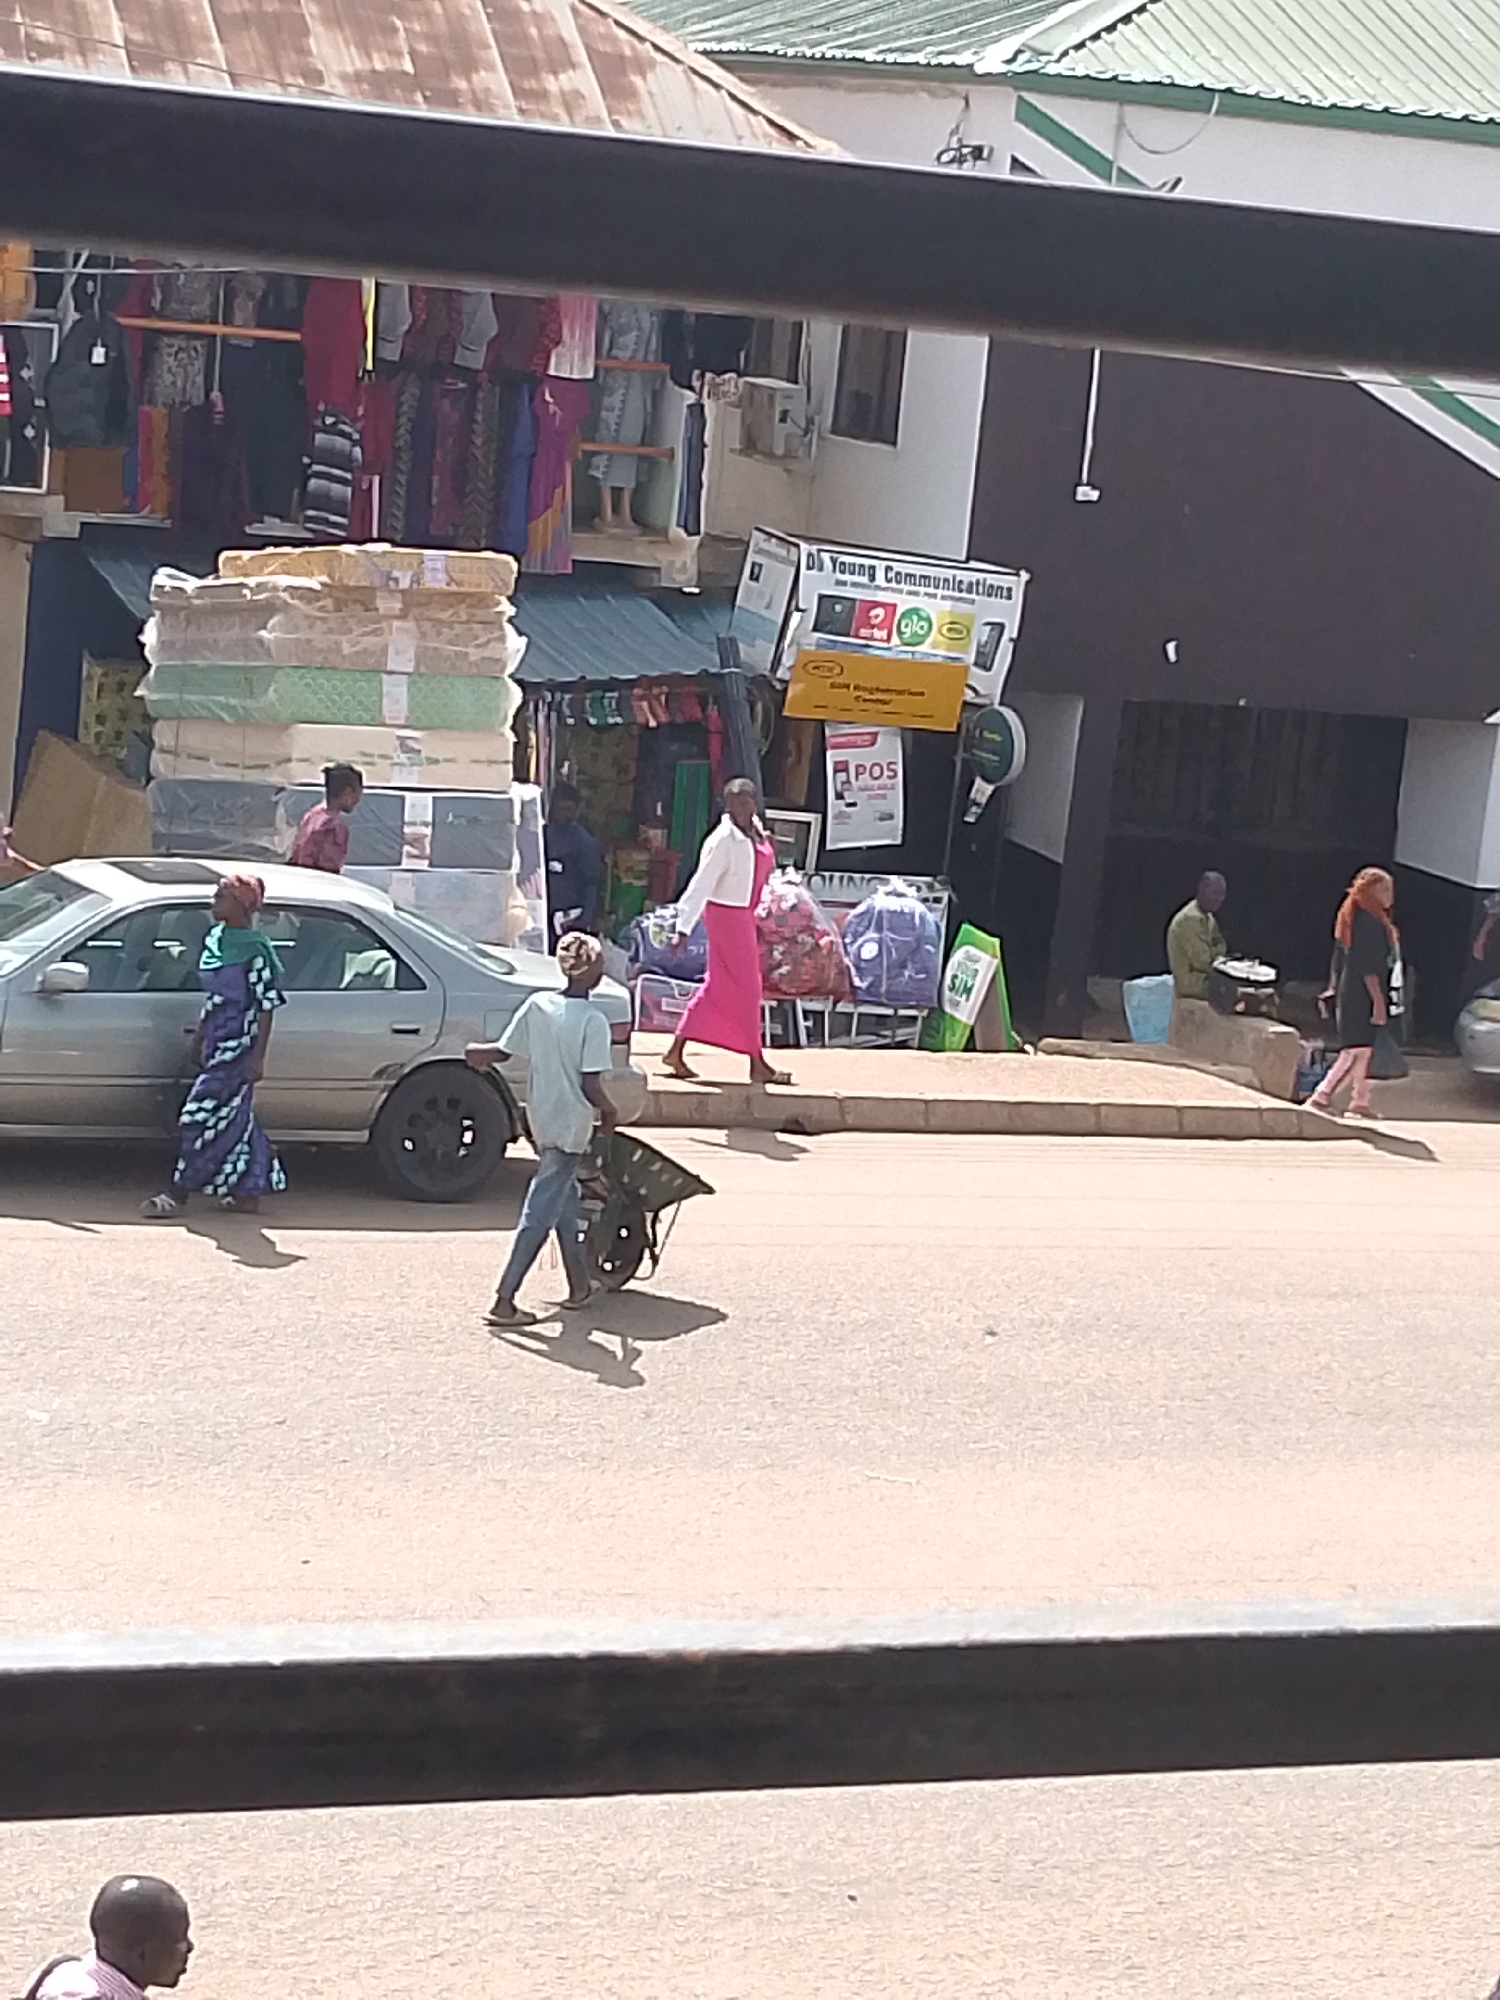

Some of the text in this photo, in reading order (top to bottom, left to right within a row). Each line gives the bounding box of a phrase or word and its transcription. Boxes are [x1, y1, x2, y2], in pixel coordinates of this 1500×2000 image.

[829, 555, 877, 583] Young
[884, 564, 1013, 601] Communications
[900, 615, 928, 638] glo
[855, 761, 898, 782] POS
[948, 973, 977, 1003] SIM
